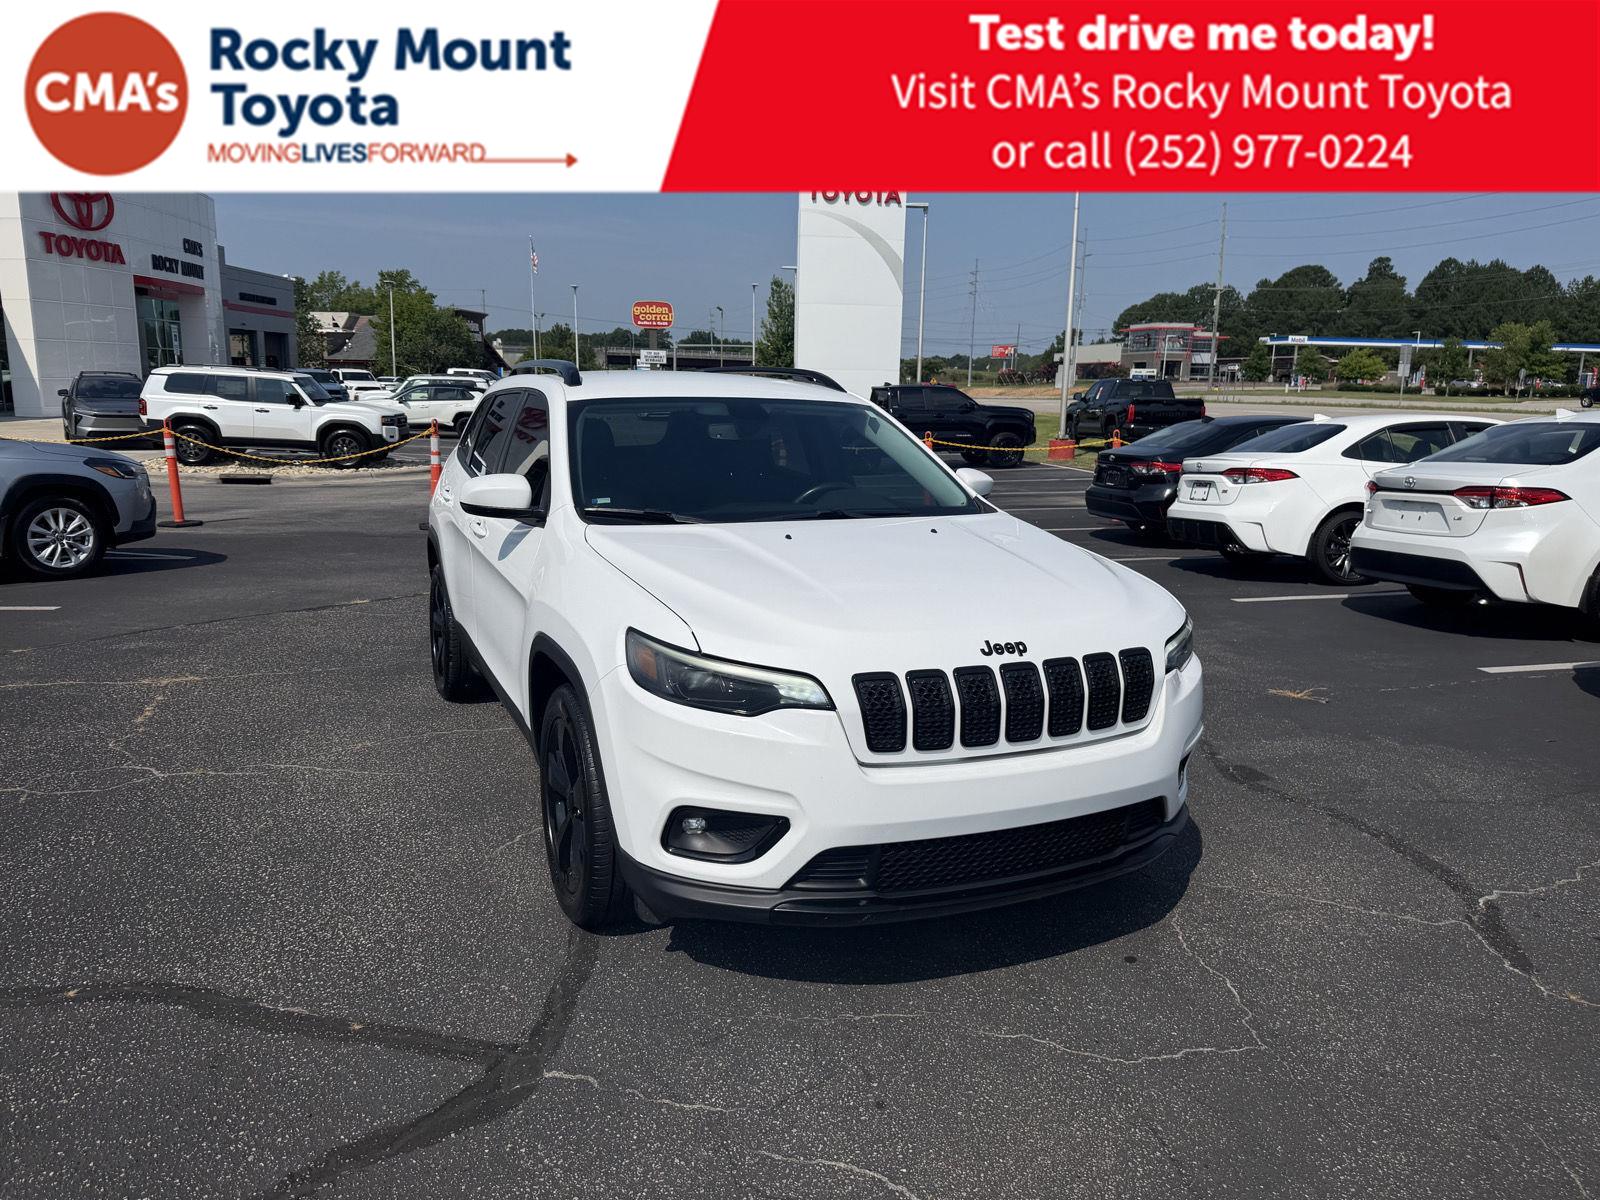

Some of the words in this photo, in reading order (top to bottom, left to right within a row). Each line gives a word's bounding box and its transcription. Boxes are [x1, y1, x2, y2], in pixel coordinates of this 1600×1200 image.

[39, 231, 126, 265] TOYOTA
[152, 254, 179, 274] ROCKY
[633, 305, 669, 315] golden
[639, 313, 673, 321] corral
[980, 640, 1028, 657] Jeep
